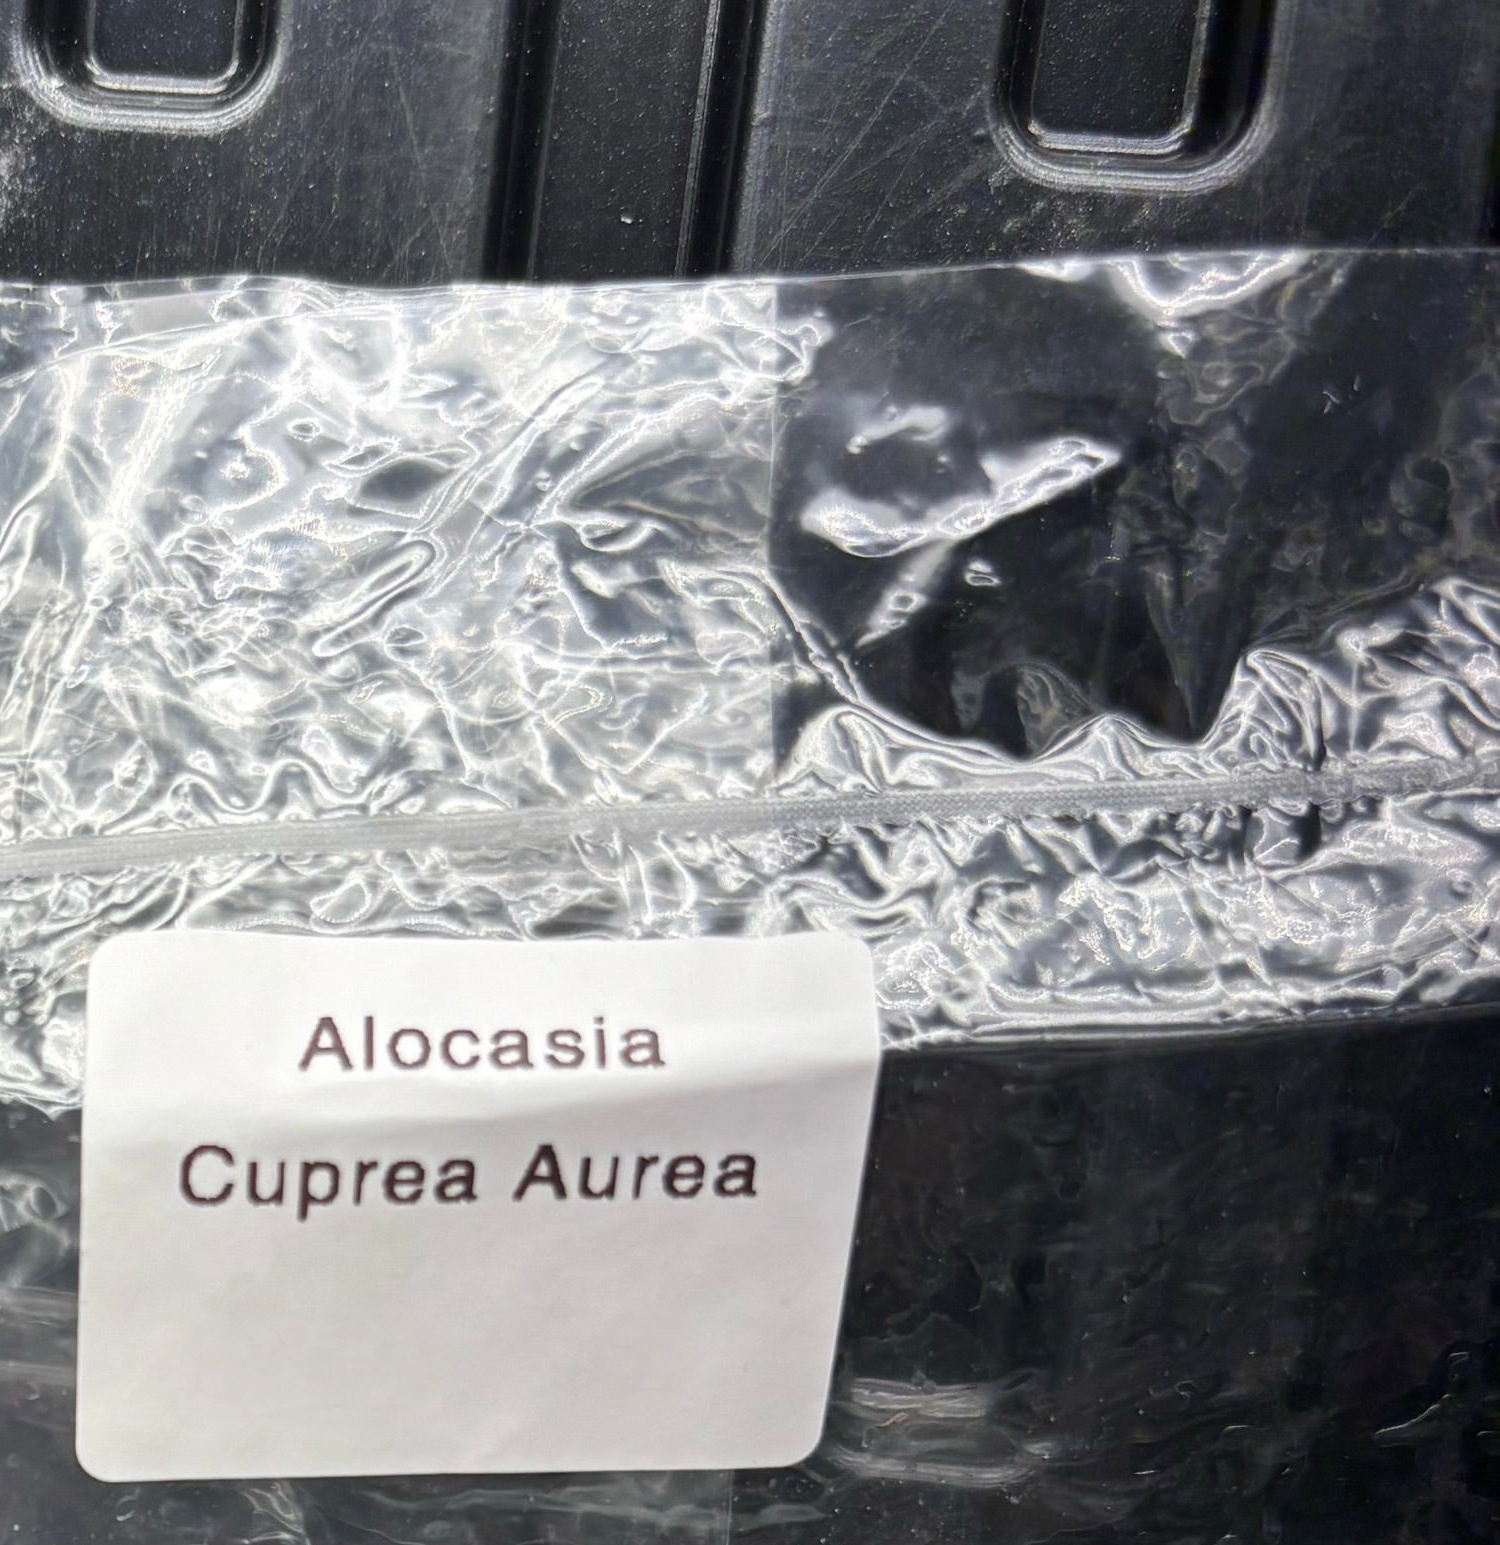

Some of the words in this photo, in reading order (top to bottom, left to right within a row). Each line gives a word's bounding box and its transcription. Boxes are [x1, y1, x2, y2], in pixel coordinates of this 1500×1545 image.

[297, 1014, 667, 1072] Alocasia
[179, 1143, 479, 1223] Cuprea
[512, 1142, 758, 1202] Aurea
